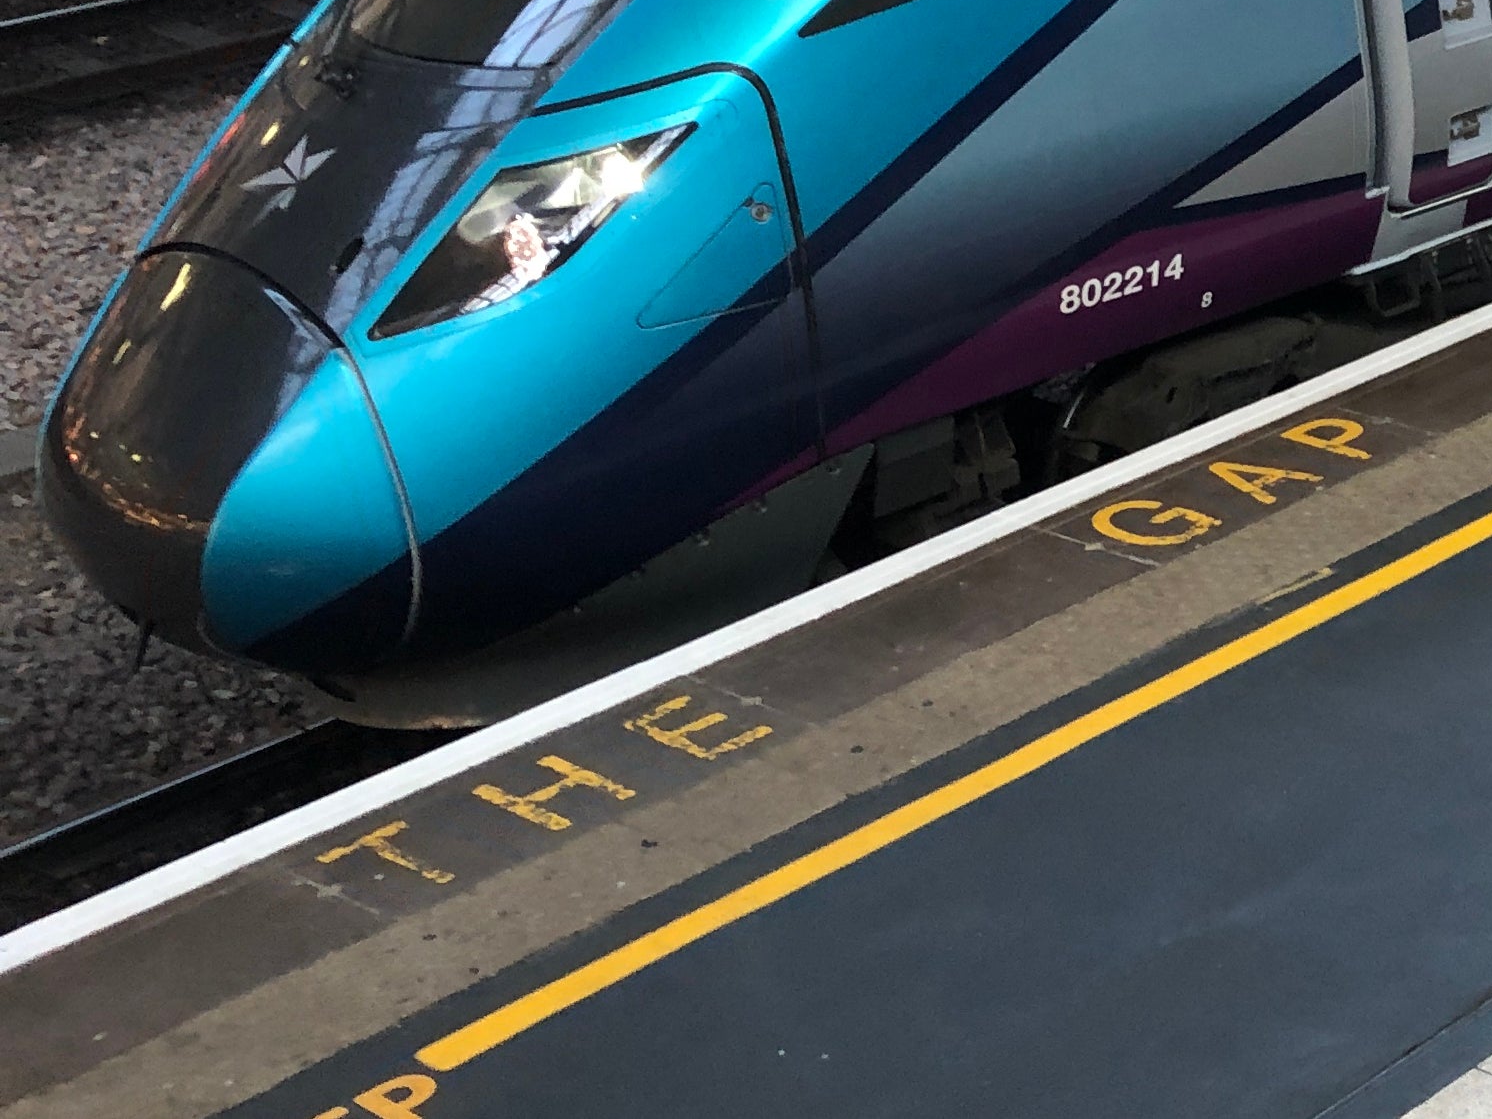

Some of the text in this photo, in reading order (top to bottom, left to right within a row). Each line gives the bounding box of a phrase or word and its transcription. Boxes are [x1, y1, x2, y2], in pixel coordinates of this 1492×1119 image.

[1059, 253, 1185, 315] 802214
[1201, 291, 1213, 308] 8
[315, 417, 1373, 885] THE GAP
